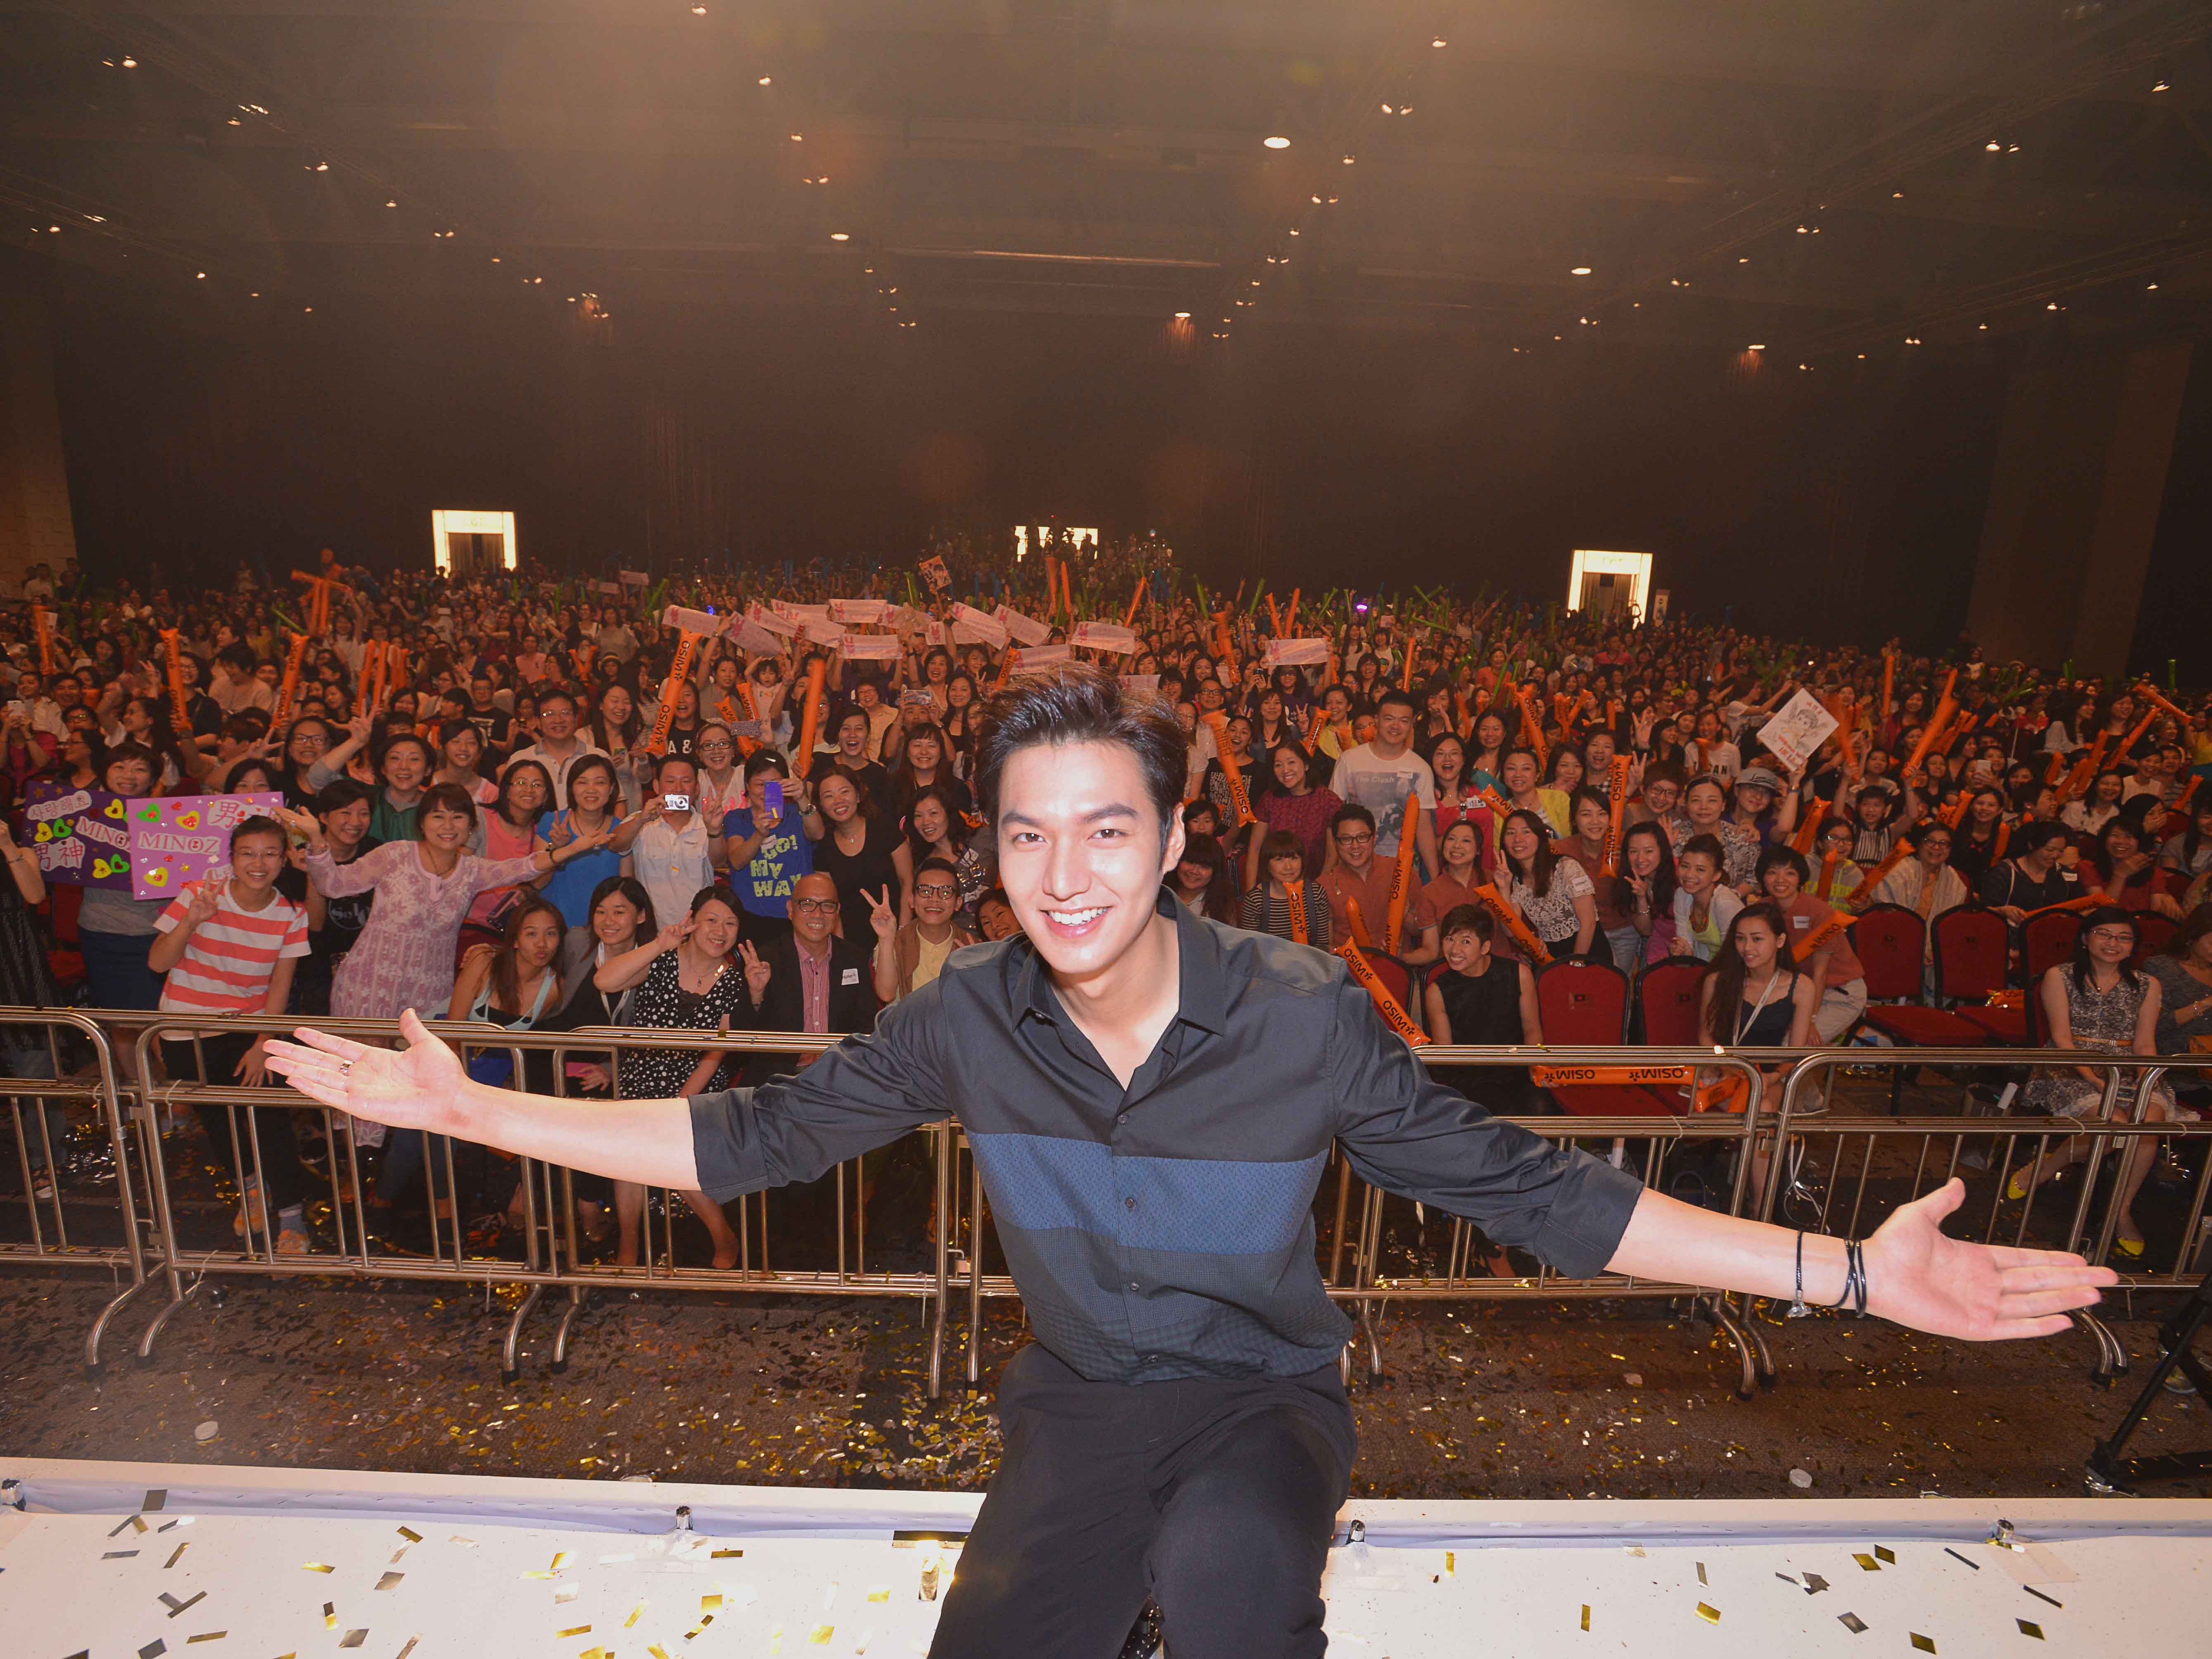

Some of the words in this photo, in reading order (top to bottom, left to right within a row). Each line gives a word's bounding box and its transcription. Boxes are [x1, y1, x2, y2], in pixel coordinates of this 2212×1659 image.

[674, 640, 689, 671] OSIM
[1001, 661, 1012, 678] OSIM
[655, 705, 670, 738] OSIM
[1525, 698, 1537, 720] OSIM
[1235, 786, 1248, 814] OSIM
[1612, 771, 1623, 801] OSIM
[32, 795, 89, 820] 사랑해요
[78, 818, 131, 849] MINO
[140, 832, 219, 854] MINOZ
[36, 839, 83, 870] 男神
[1606, 834, 1616, 865] OSIM
[750, 859, 783, 879] MY
[1392, 867, 1402, 900] OSIM
[1291, 892, 1302, 925] OSIM
[1485, 898, 1507, 918] OSIM
[1344, 948, 1367, 975] OSIM
[1383, 1000, 1408, 1030] OSIM
[1556, 1069, 1595, 1080] OSIM
[1641, 1068, 1684, 1079] OSIM
